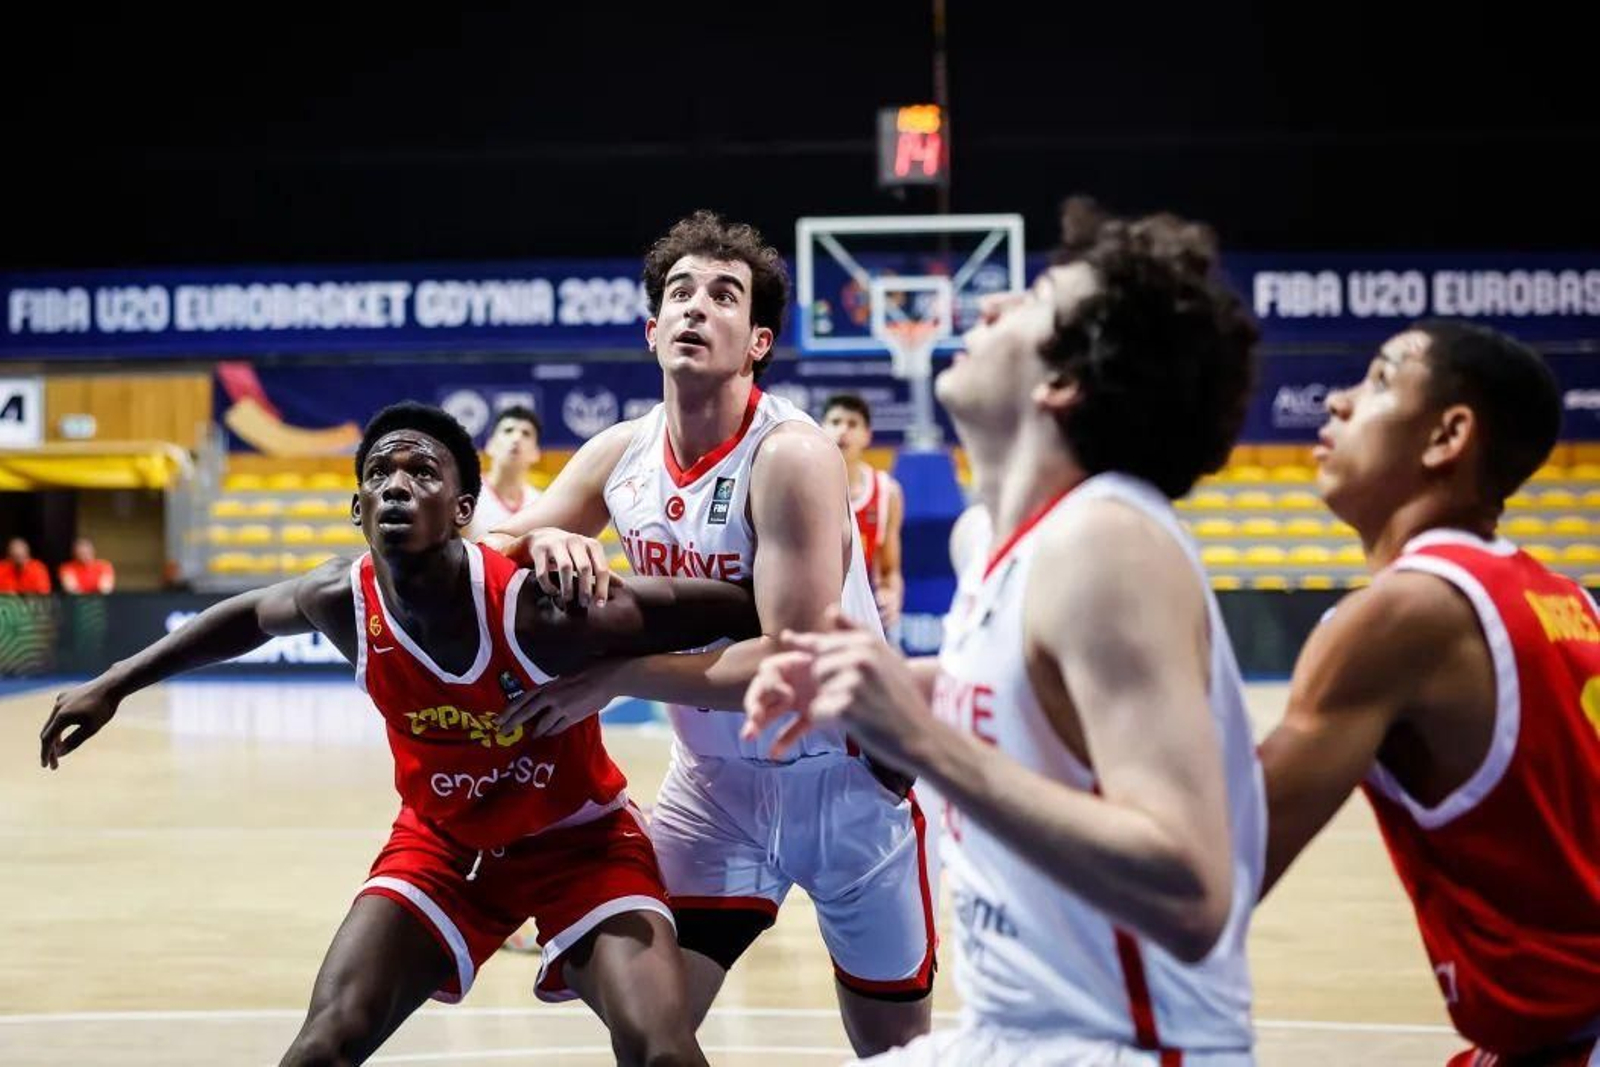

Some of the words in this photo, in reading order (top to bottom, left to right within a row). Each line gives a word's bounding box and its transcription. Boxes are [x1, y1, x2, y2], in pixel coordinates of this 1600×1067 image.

[10, 287, 89, 332] FIBA
[97, 285, 169, 332] U20
[175, 282, 411, 330] EUROBASKET
[416, 279, 554, 327] GDYNIA
[1254, 271, 1341, 318] FIBA
[1349, 271, 1425, 317] U20
[1434, 270, 1600, 316] EUROBAS
[622, 529, 742, 583] ÜRKİYE
